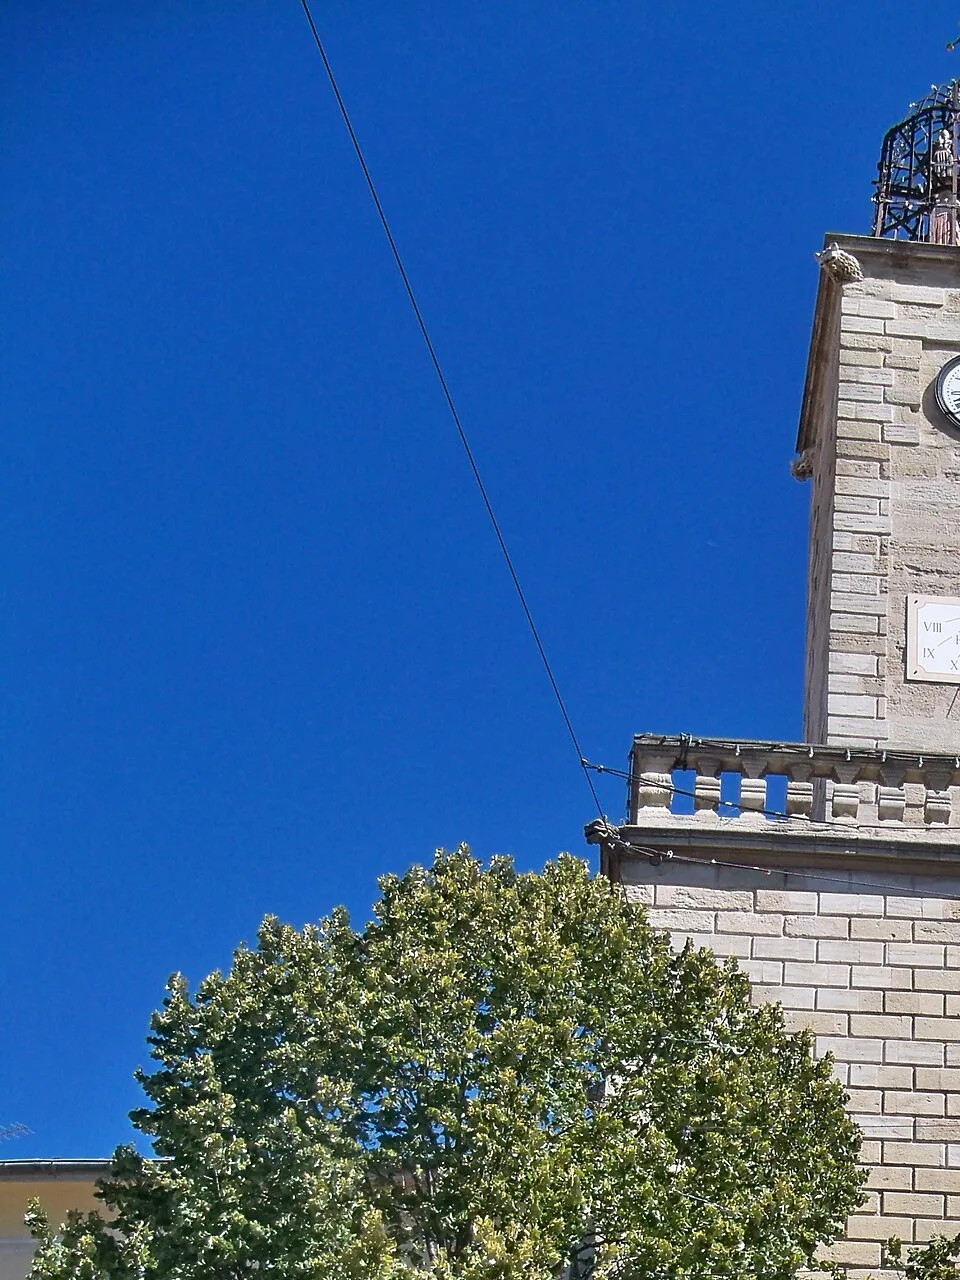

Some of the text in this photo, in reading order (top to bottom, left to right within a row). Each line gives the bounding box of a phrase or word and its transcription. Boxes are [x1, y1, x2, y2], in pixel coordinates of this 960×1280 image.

[923, 621, 942, 633] VIII
[923, 647, 935, 659] IX
[950, 659, 958, 671] X
